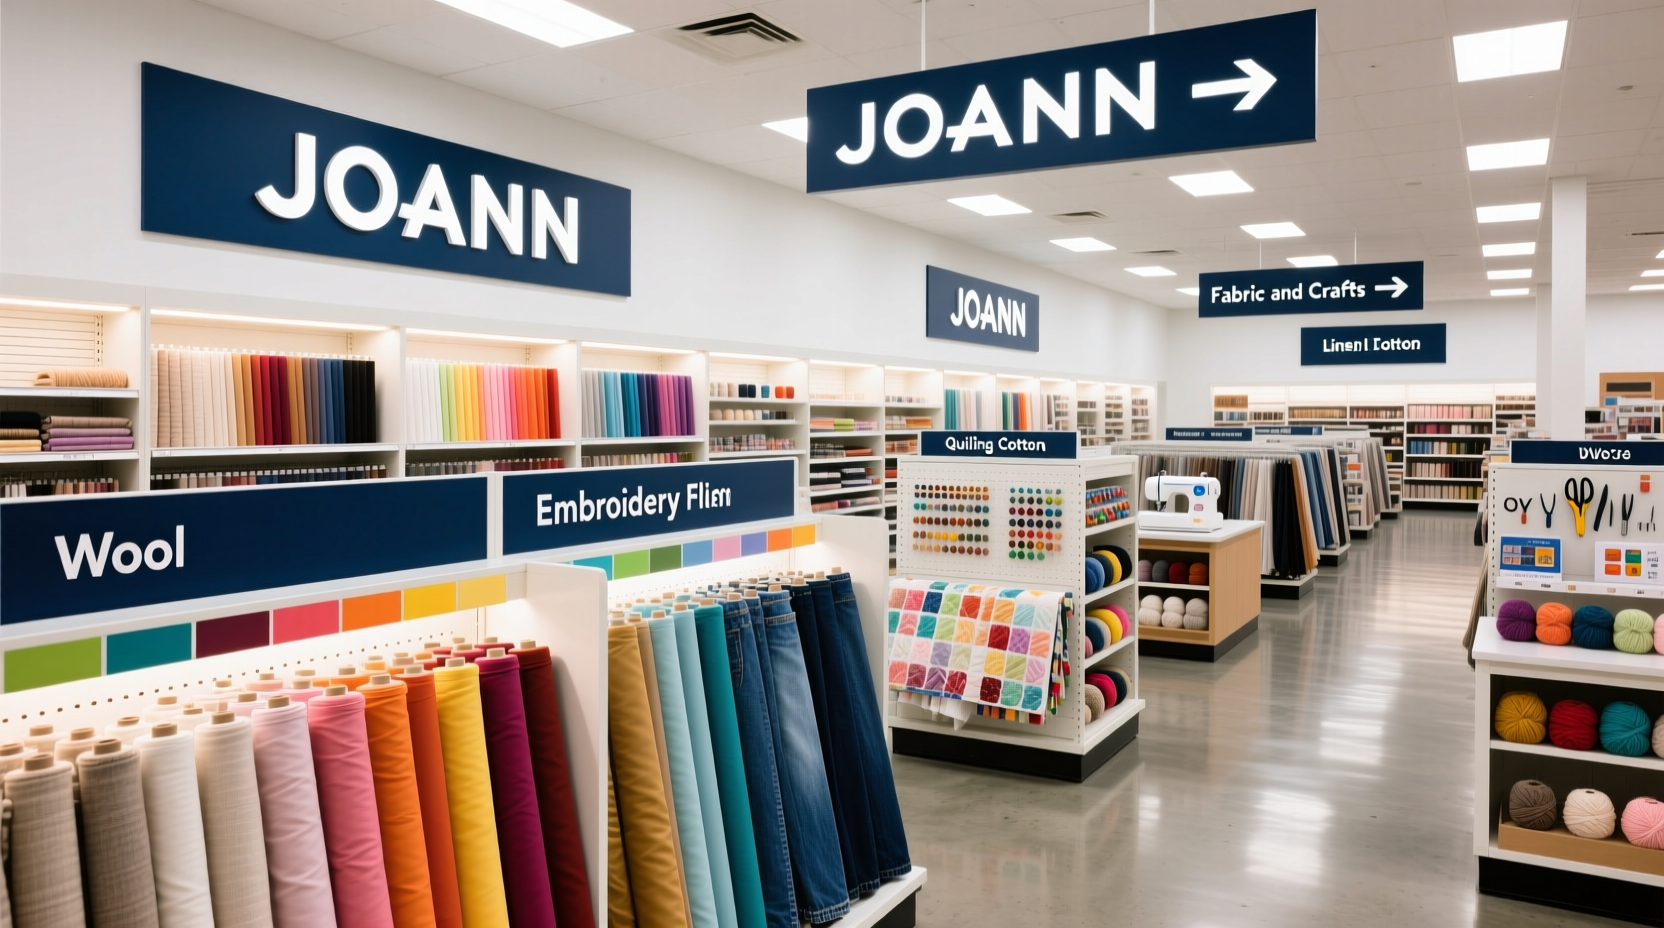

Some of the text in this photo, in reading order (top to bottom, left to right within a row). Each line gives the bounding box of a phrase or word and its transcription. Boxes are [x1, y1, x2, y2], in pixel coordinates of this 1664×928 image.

[836, 60, 1156, 166] JOANN
[254, 132, 580, 265] JOANN
[950, 287, 1026, 338] JOANN
[1211, 279, 1366, 304] Fabric and Crafts
[997, 436, 1046, 452] Cotton
[536, 484, 681, 527] Embroidery
[54, 524, 185, 581] Wool
